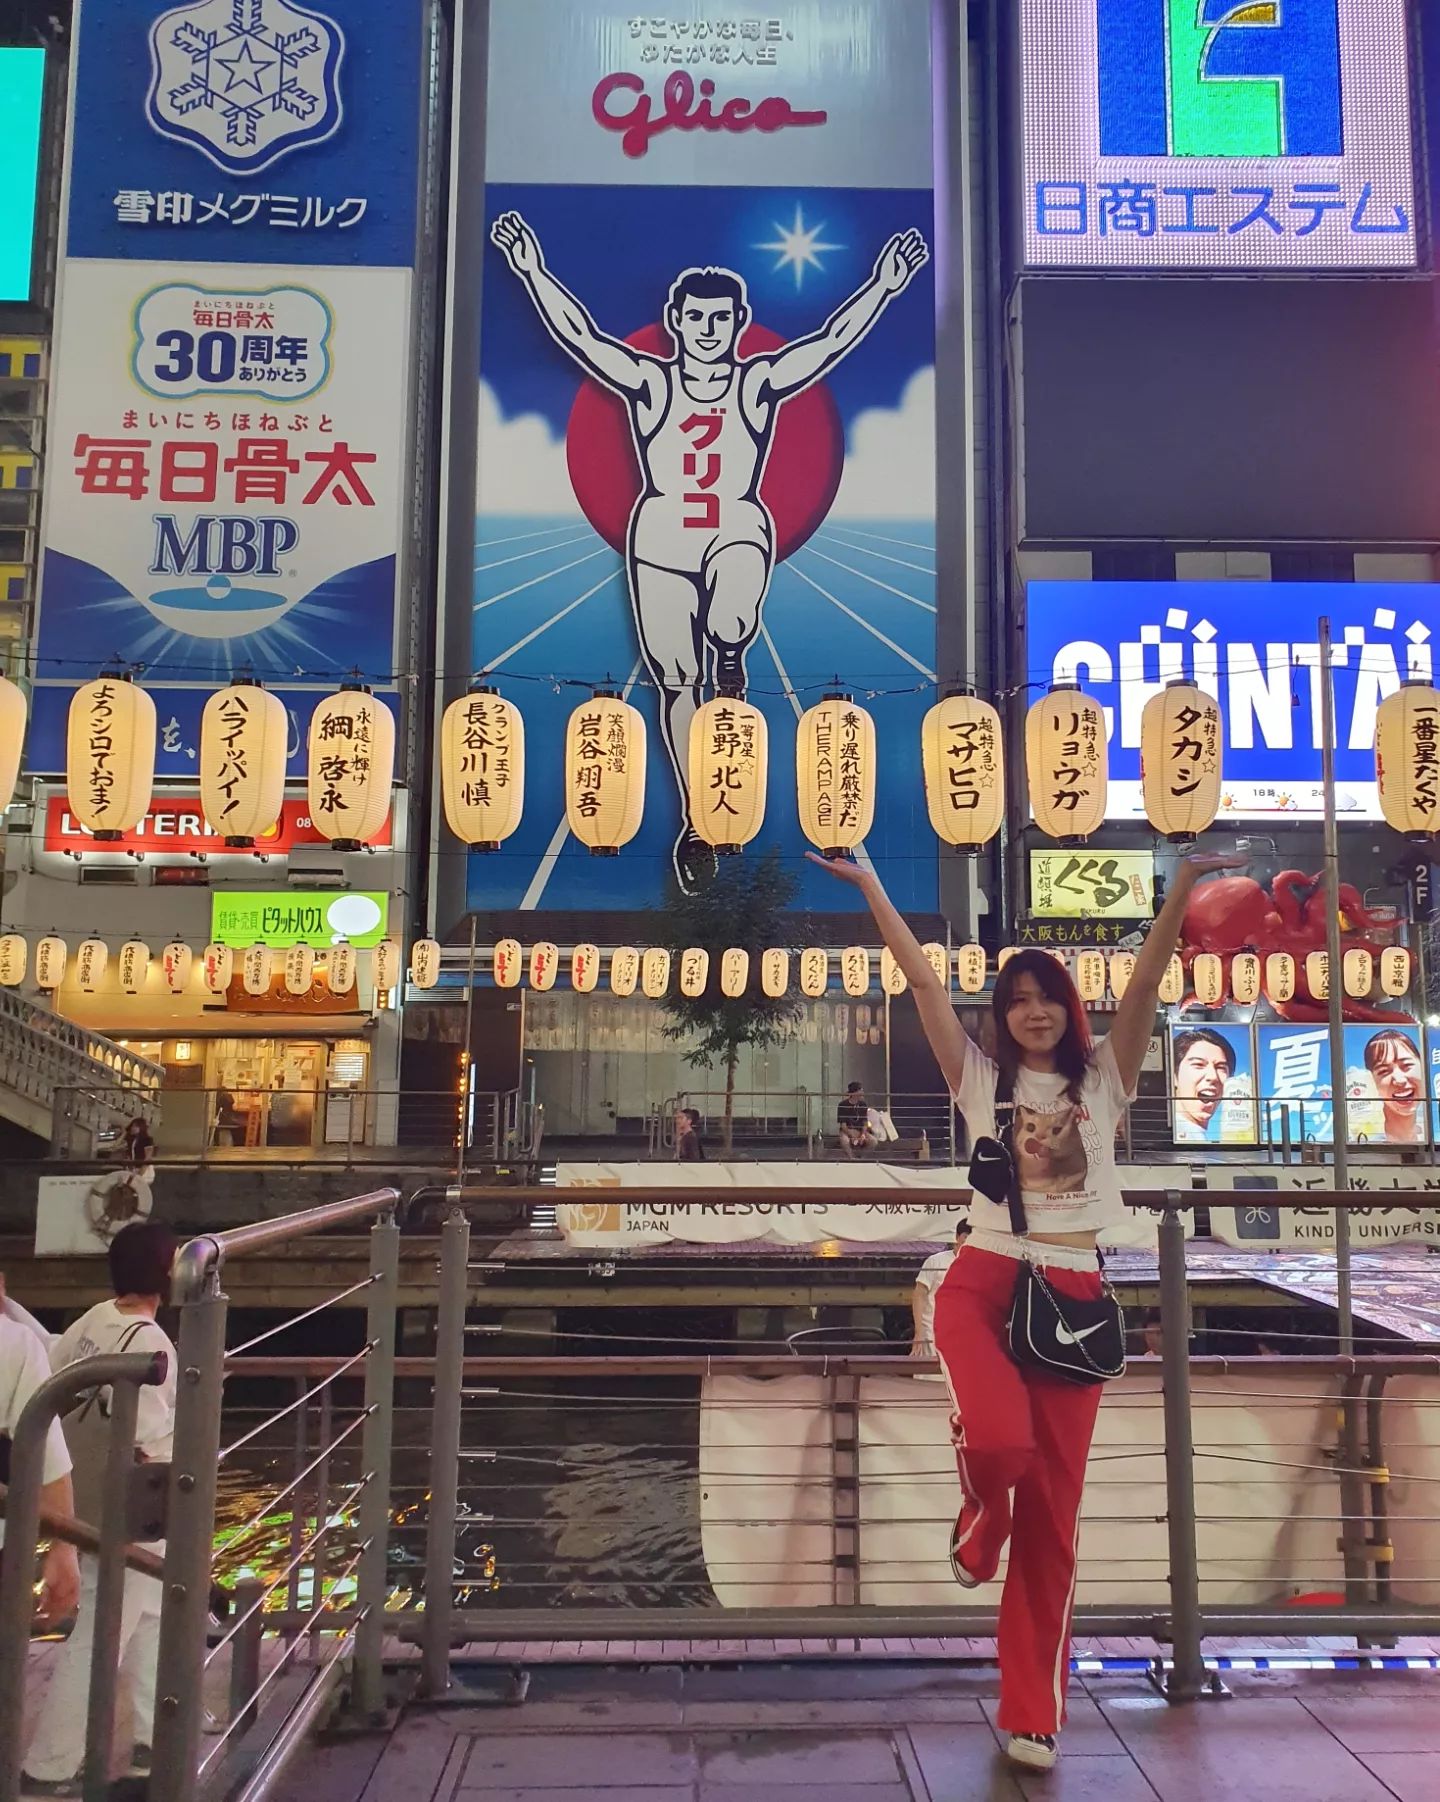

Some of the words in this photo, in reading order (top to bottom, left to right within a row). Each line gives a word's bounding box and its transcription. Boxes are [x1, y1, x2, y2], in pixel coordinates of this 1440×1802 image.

[640, 45, 777, 65] ゆたかな人生
[113, 190, 368, 229] 雪印メグミルク
[1036, 179, 1408, 236] 日商エステム
[193, 301, 277, 310] まいにちほねぶと
[193, 310, 276, 330] 毎日骨太
[239, 366, 307, 383] ありがとう
[122, 409, 334, 434] まいにちほねぶと
[73, 434, 377, 507] 毎日骨太
[679, 407, 727, 525] グリコ
[148, 513, 299, 578] MBP
[317, 713, 353, 813] 綱啓永
[350, 708, 372, 786] 永遠に輝け
[460, 702, 495, 807] 長谷川慎
[575, 713, 607, 818] 岩谷翔吾
[710, 708, 743, 816] 吉野北人
[839, 711, 862, 828] 乗り遅れ厳禁だ
[946, 722, 980, 810] マサヒロ
[1052, 712, 1090, 811] リョウガ
[1170, 705, 1203, 797] タカシ
[1411, 706, 1439, 815] 一番星たくや
[262, 907, 323, 933] ピタットハウス
[1054, 859, 1129, 908] くくる
[1022, 922, 1125, 942] 大阪もんを食す
[1264, 1029, 1329, 1121] 夏
[626, 1221, 670, 1232] JAPAN
